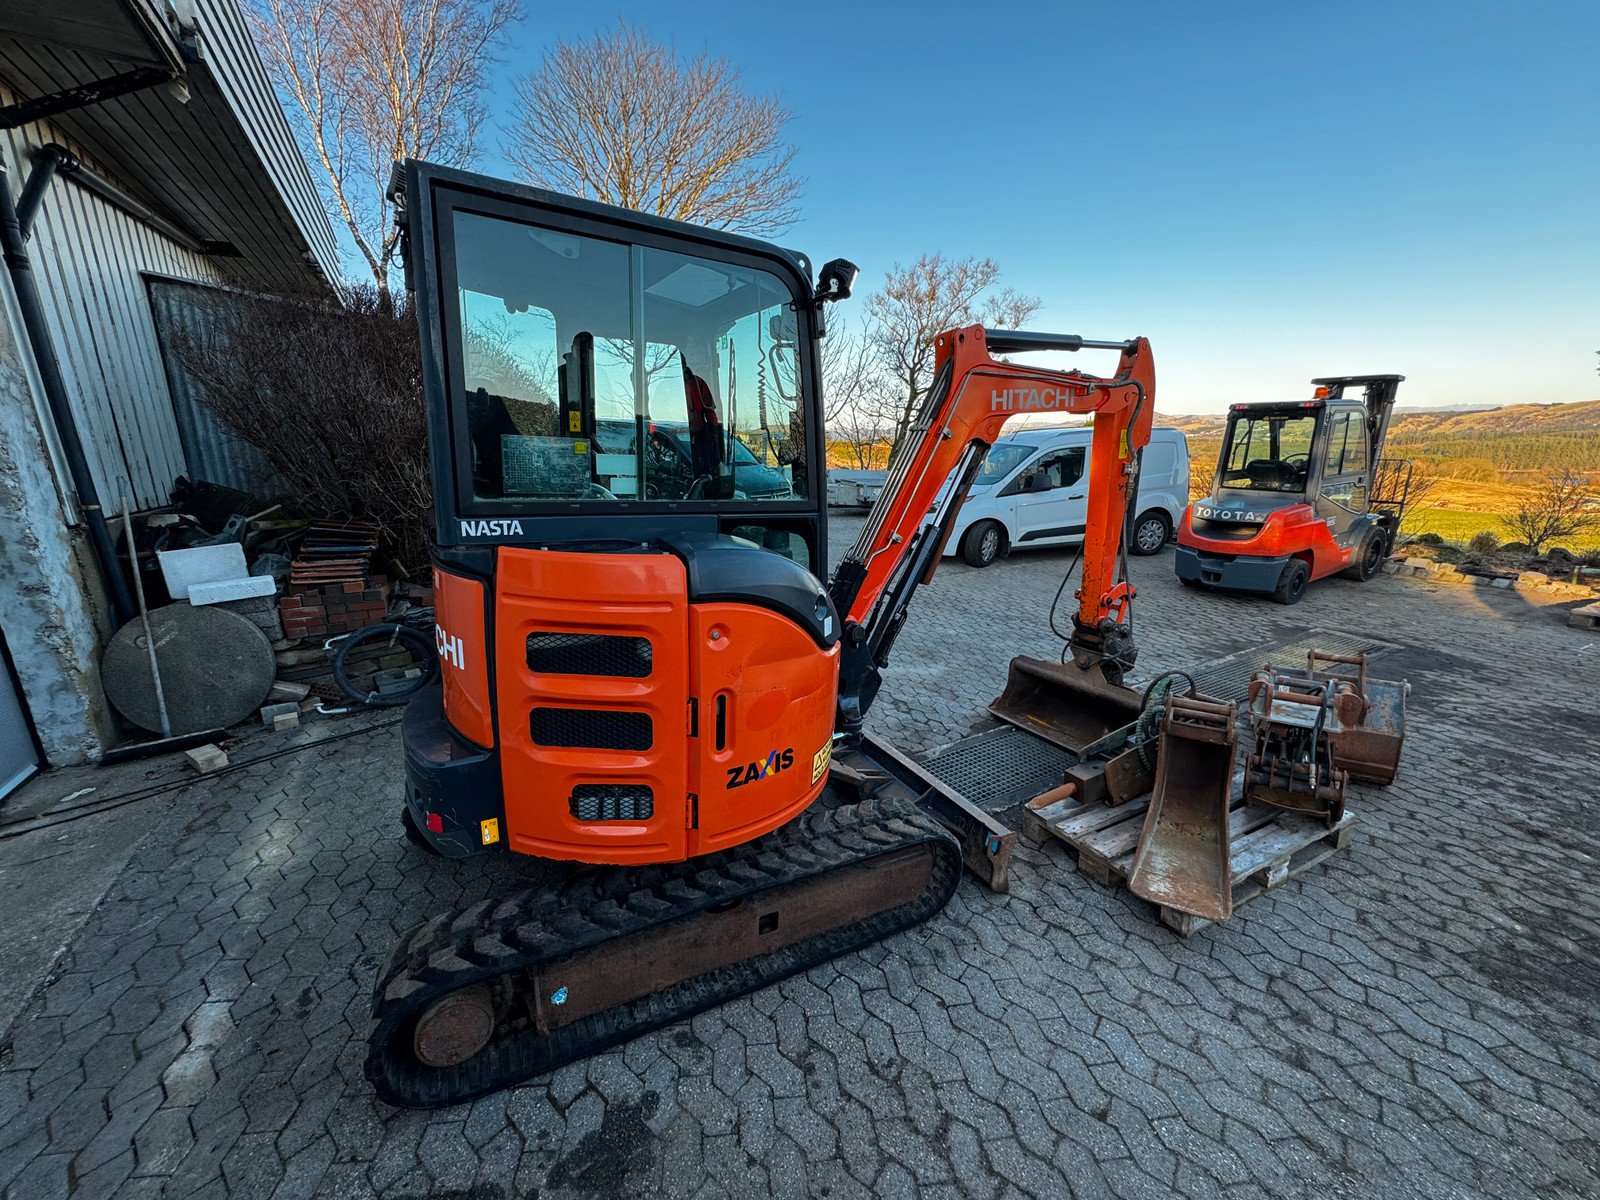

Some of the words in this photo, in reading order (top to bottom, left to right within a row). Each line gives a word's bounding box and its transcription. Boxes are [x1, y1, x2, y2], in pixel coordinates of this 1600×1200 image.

[991, 388, 1075, 411] HITACHI
[1196, 506, 1255, 520] TOYOTA
[461, 520, 524, 537] NASTA
[435, 623, 465, 670] CHI
[726, 748, 794, 789] ZAXIS
